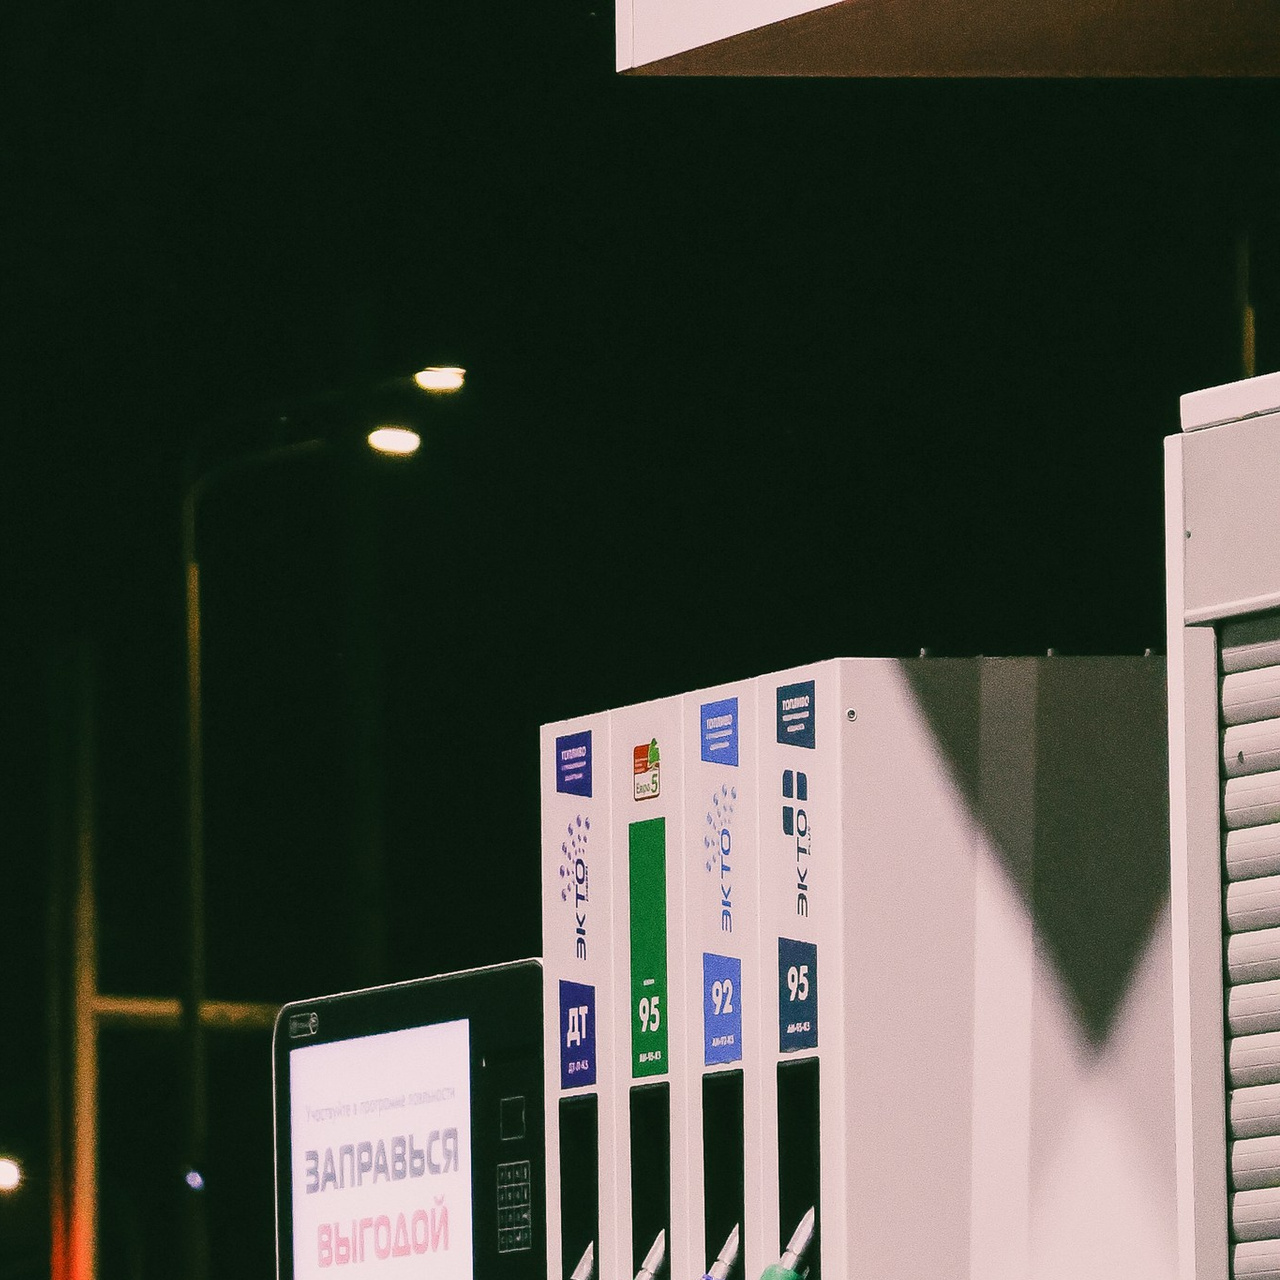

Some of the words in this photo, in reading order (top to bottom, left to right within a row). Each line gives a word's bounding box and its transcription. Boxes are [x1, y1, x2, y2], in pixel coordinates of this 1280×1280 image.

[651, 774, 658, 793] 5
[720, 828, 732, 933] ЭКТО
[796, 809, 809, 918] ЭКТО
[575, 858, 587, 961] ЭКТО
[711, 978, 733, 1016] 92
[787, 965, 809, 1001] 95
[566, 1005, 589, 1048] ДТ
[639, 996, 660, 1032] 95
[305, 1127, 459, 1194] ЗАПРАВЬСЯ
[317, 1194, 449, 1269] ВЫГОДОЙ
